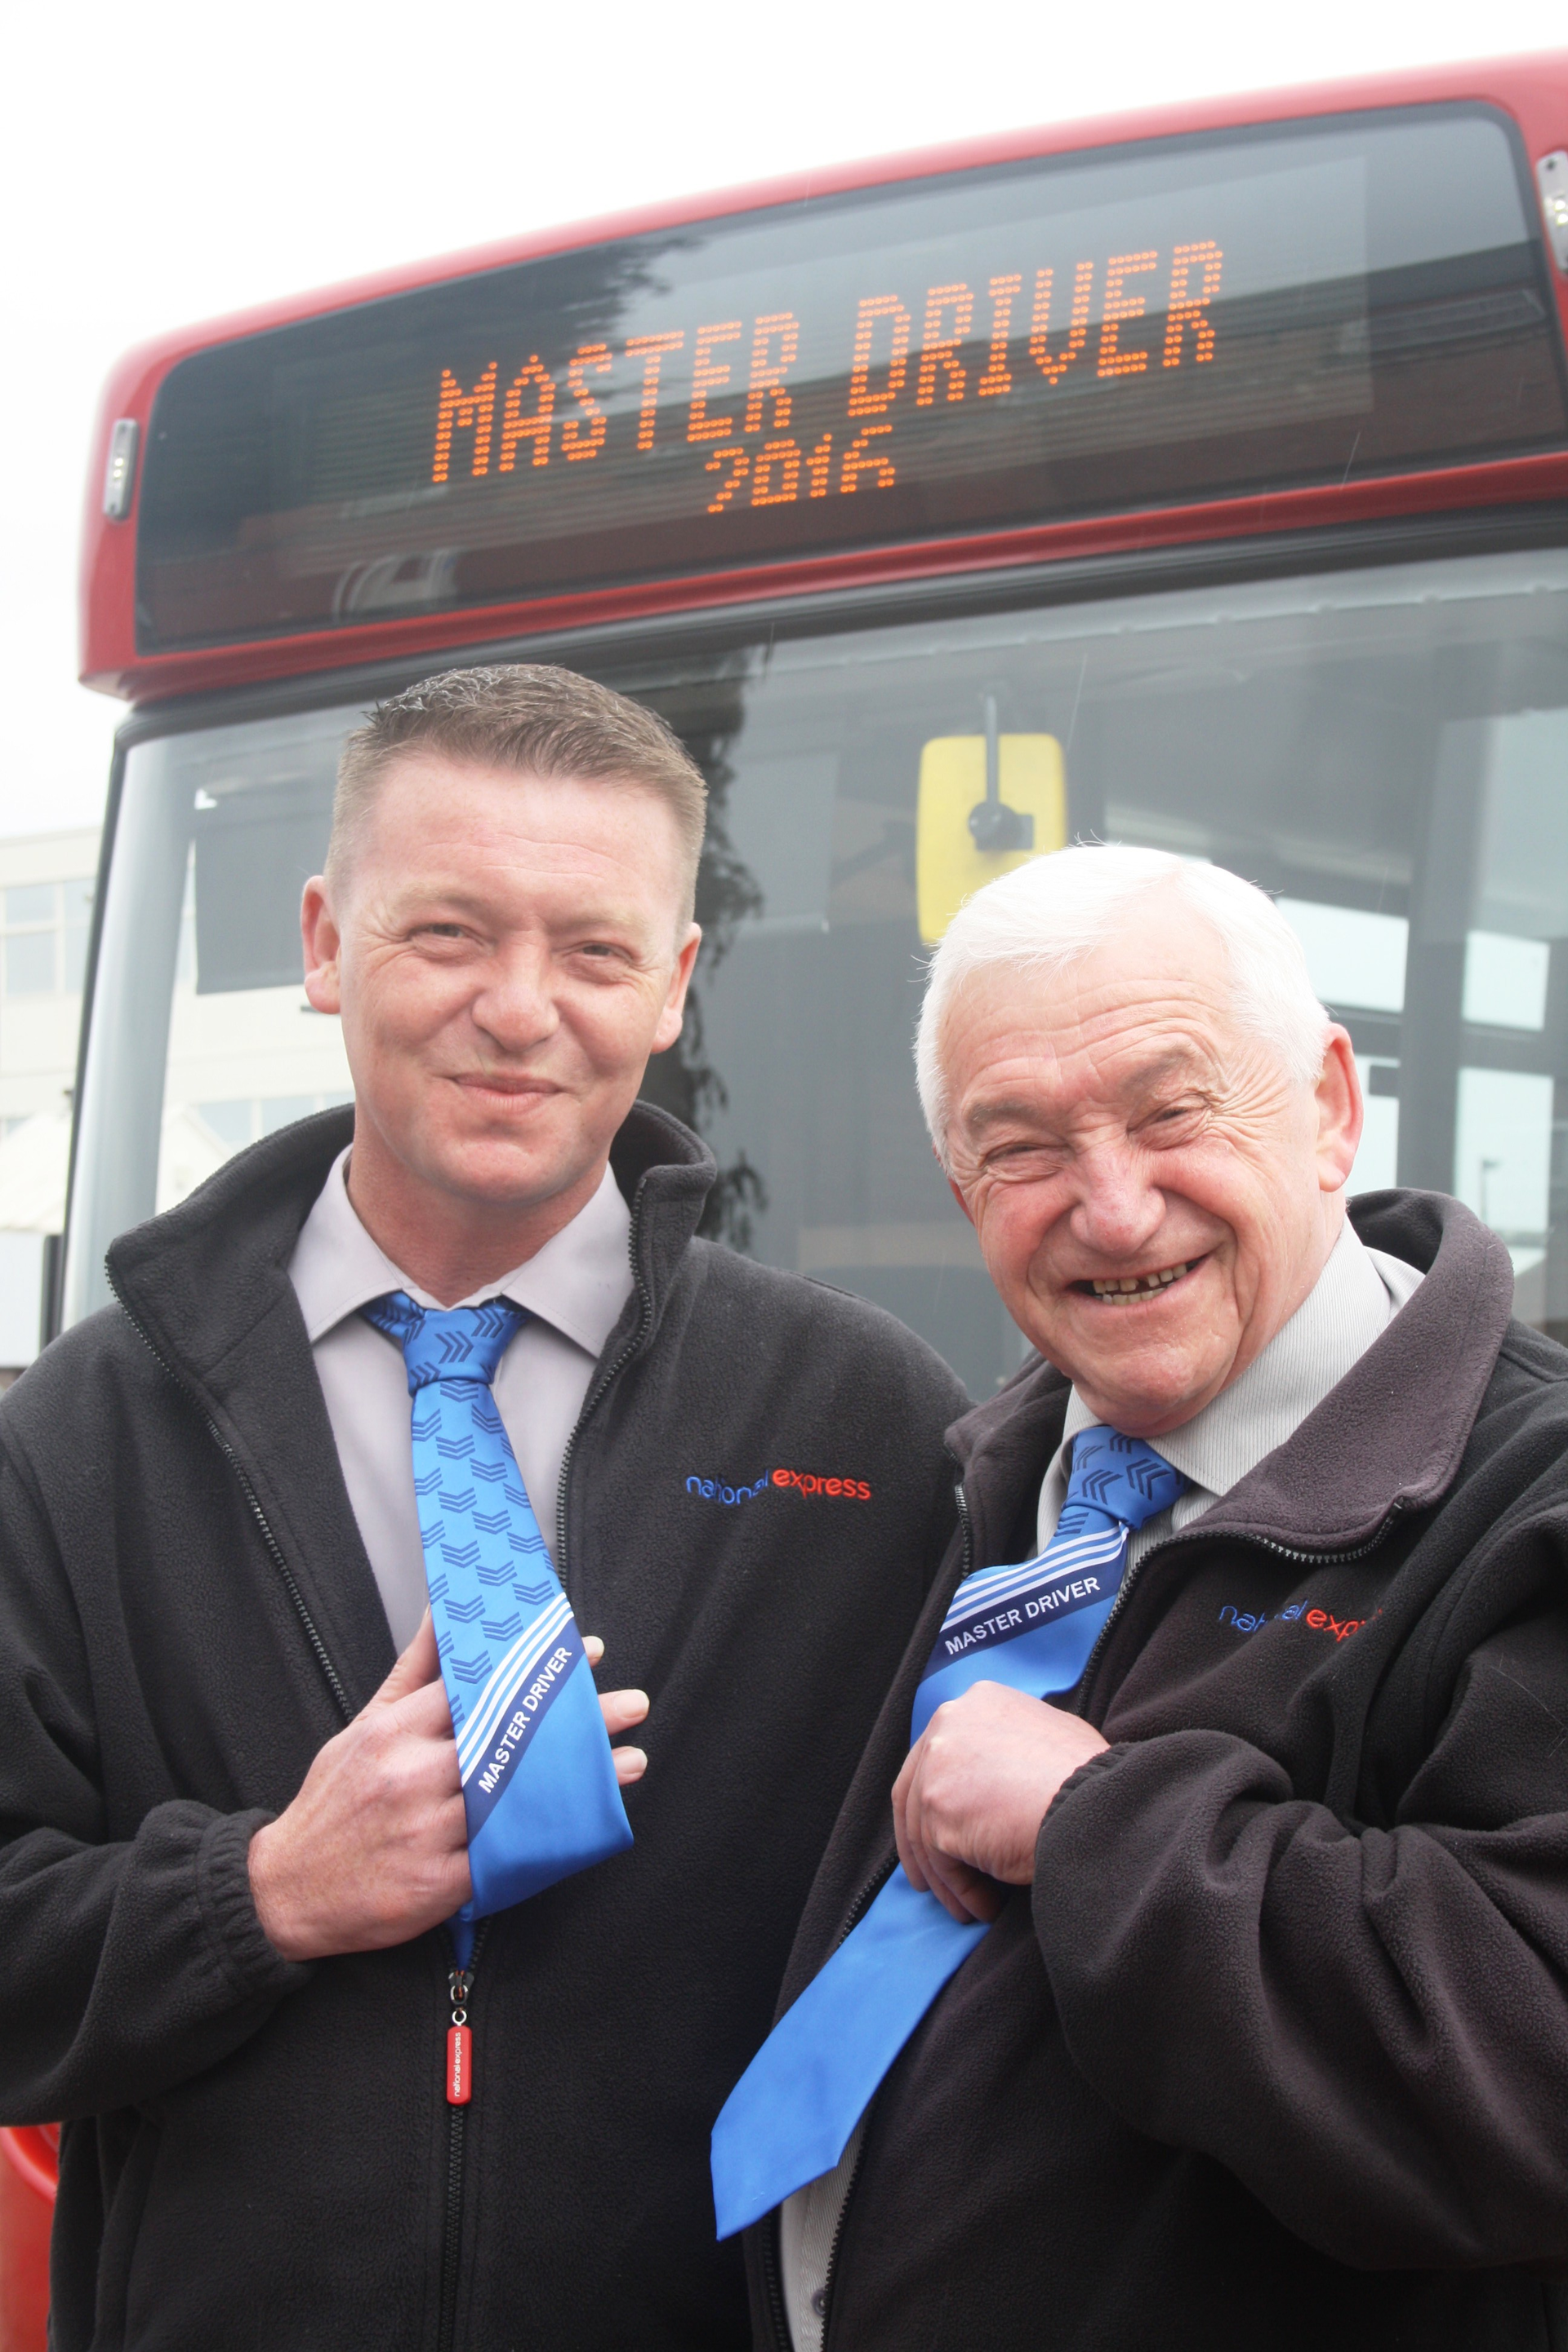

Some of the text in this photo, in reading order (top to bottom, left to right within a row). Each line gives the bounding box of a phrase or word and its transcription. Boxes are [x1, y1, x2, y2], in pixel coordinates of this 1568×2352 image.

[431, 240, 1223, 483] MASTER DRIVER
[705, 424, 896, 513] 2016
[685, 1468, 872, 1505] national express
[944, 1576, 1101, 1655] MASTER DRIVER
[1219, 1599, 1308, 1633] natal
[478, 1646, 572, 1793] MASTER DRIVER
[452, 2031, 462, 2097] national express
